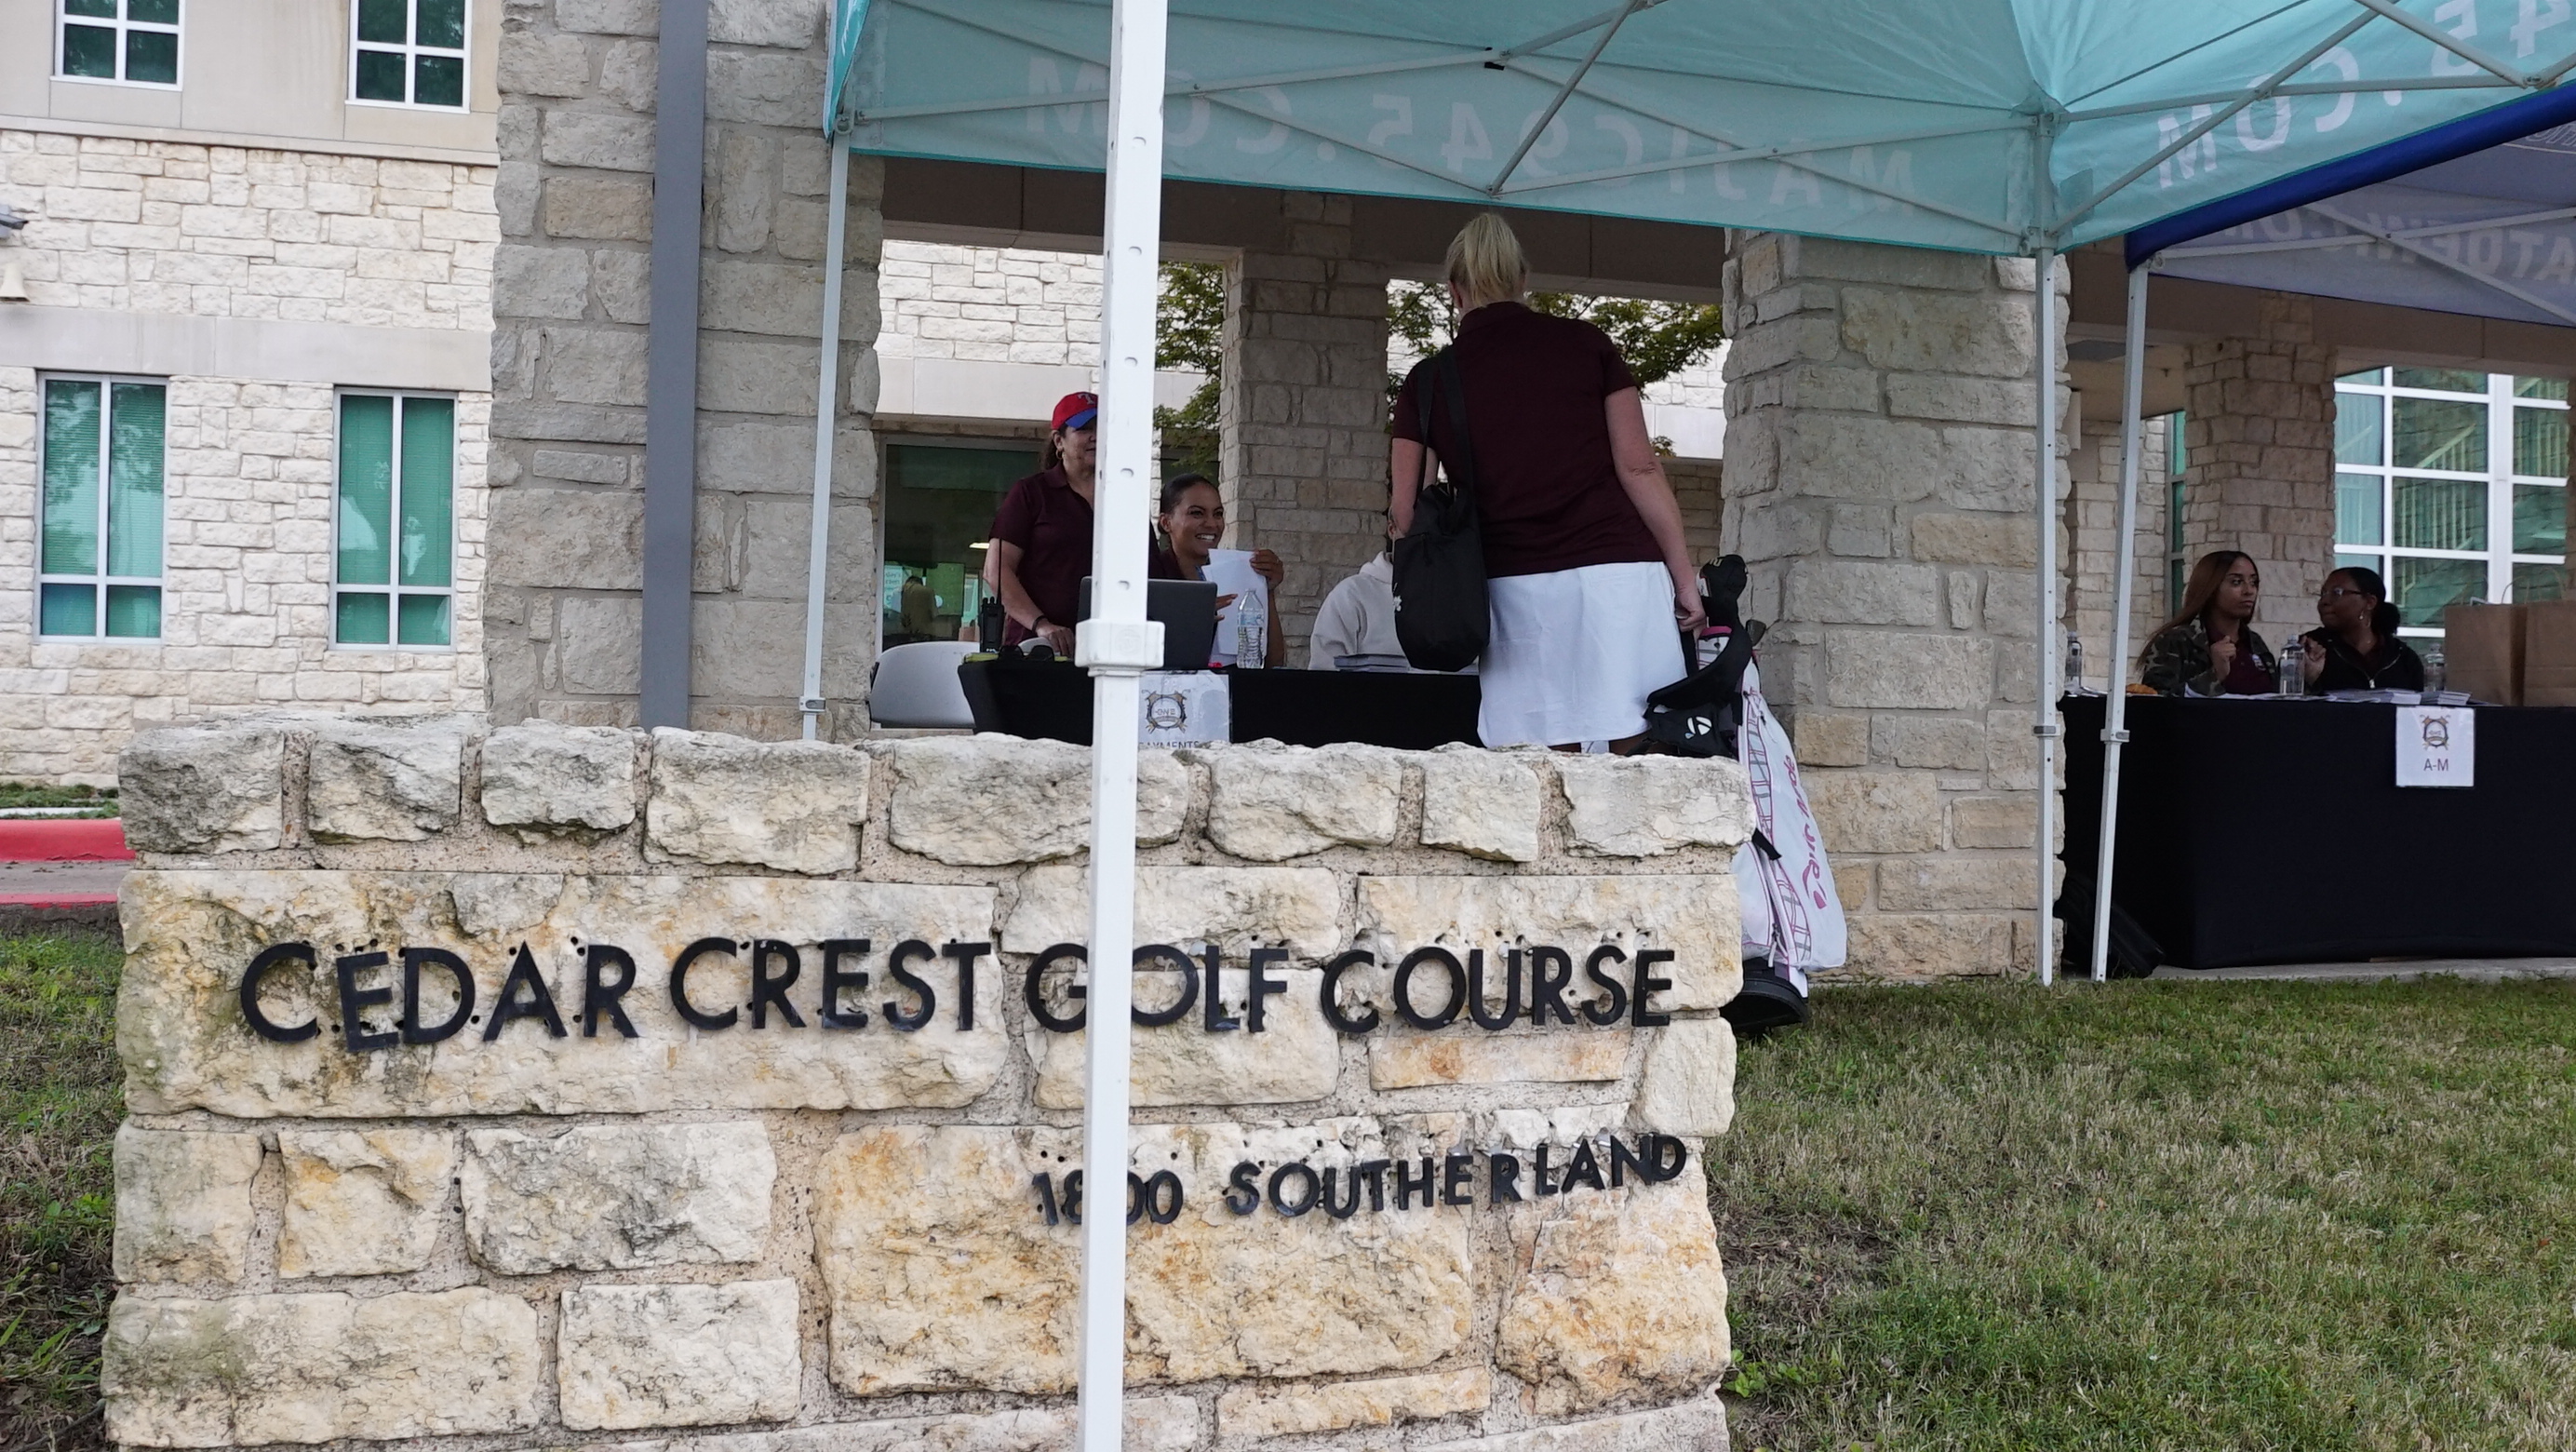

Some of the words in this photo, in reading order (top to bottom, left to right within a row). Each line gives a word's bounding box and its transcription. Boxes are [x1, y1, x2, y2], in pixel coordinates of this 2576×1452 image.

[2423, 758, 2449, 772] A-M
[240, 940, 639, 1052] CEDAR
[669, 937, 992, 1031] CREST
[1026, 943, 1289, 1032] GOLF
[1321, 945, 1675, 1033] COURSE
[1032, 1169, 1184, 1226] 1800
[1226, 1132, 1686, 1219] SOUTHERLAND
